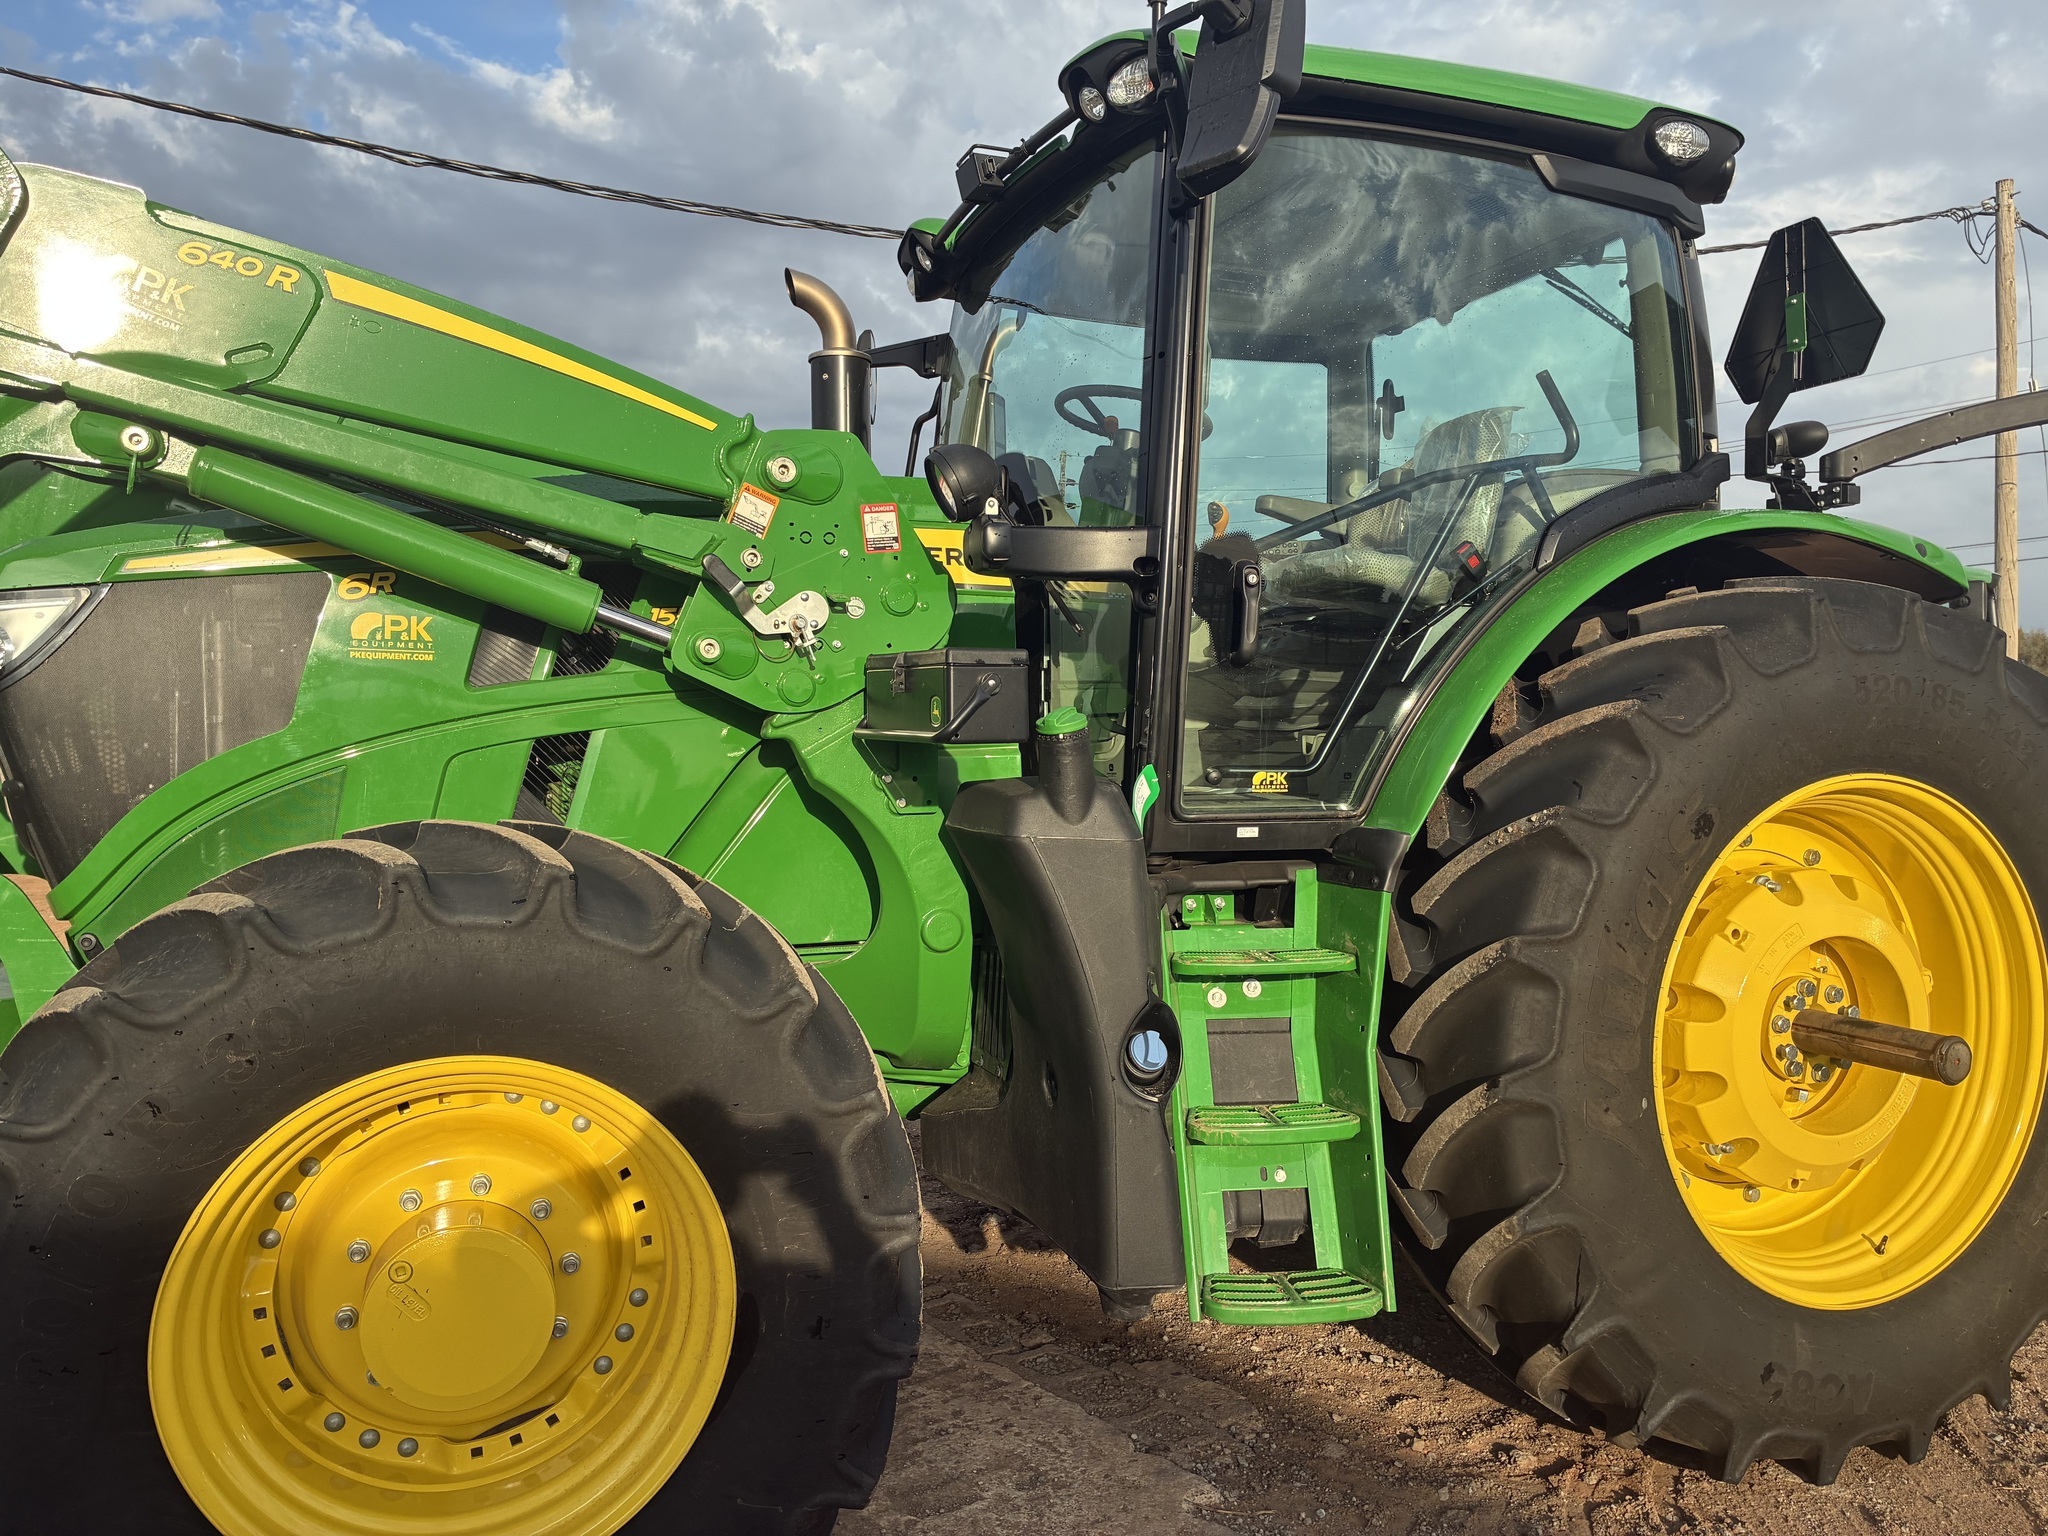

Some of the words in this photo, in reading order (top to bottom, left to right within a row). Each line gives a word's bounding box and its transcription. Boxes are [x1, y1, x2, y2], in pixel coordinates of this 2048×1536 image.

[177, 241, 264, 277] 640
[265, 264, 301, 293] R
[751, 488, 777, 505] WARNING
[337, 571, 396, 600] 6R
[349, 651, 434, 661] PKEQUIPMENT.COM
[352, 640, 433, 649] EQUIPMENT
[389, 1283, 403, 1300] OIL
[401, 1294, 426, 1318] LEVEL
